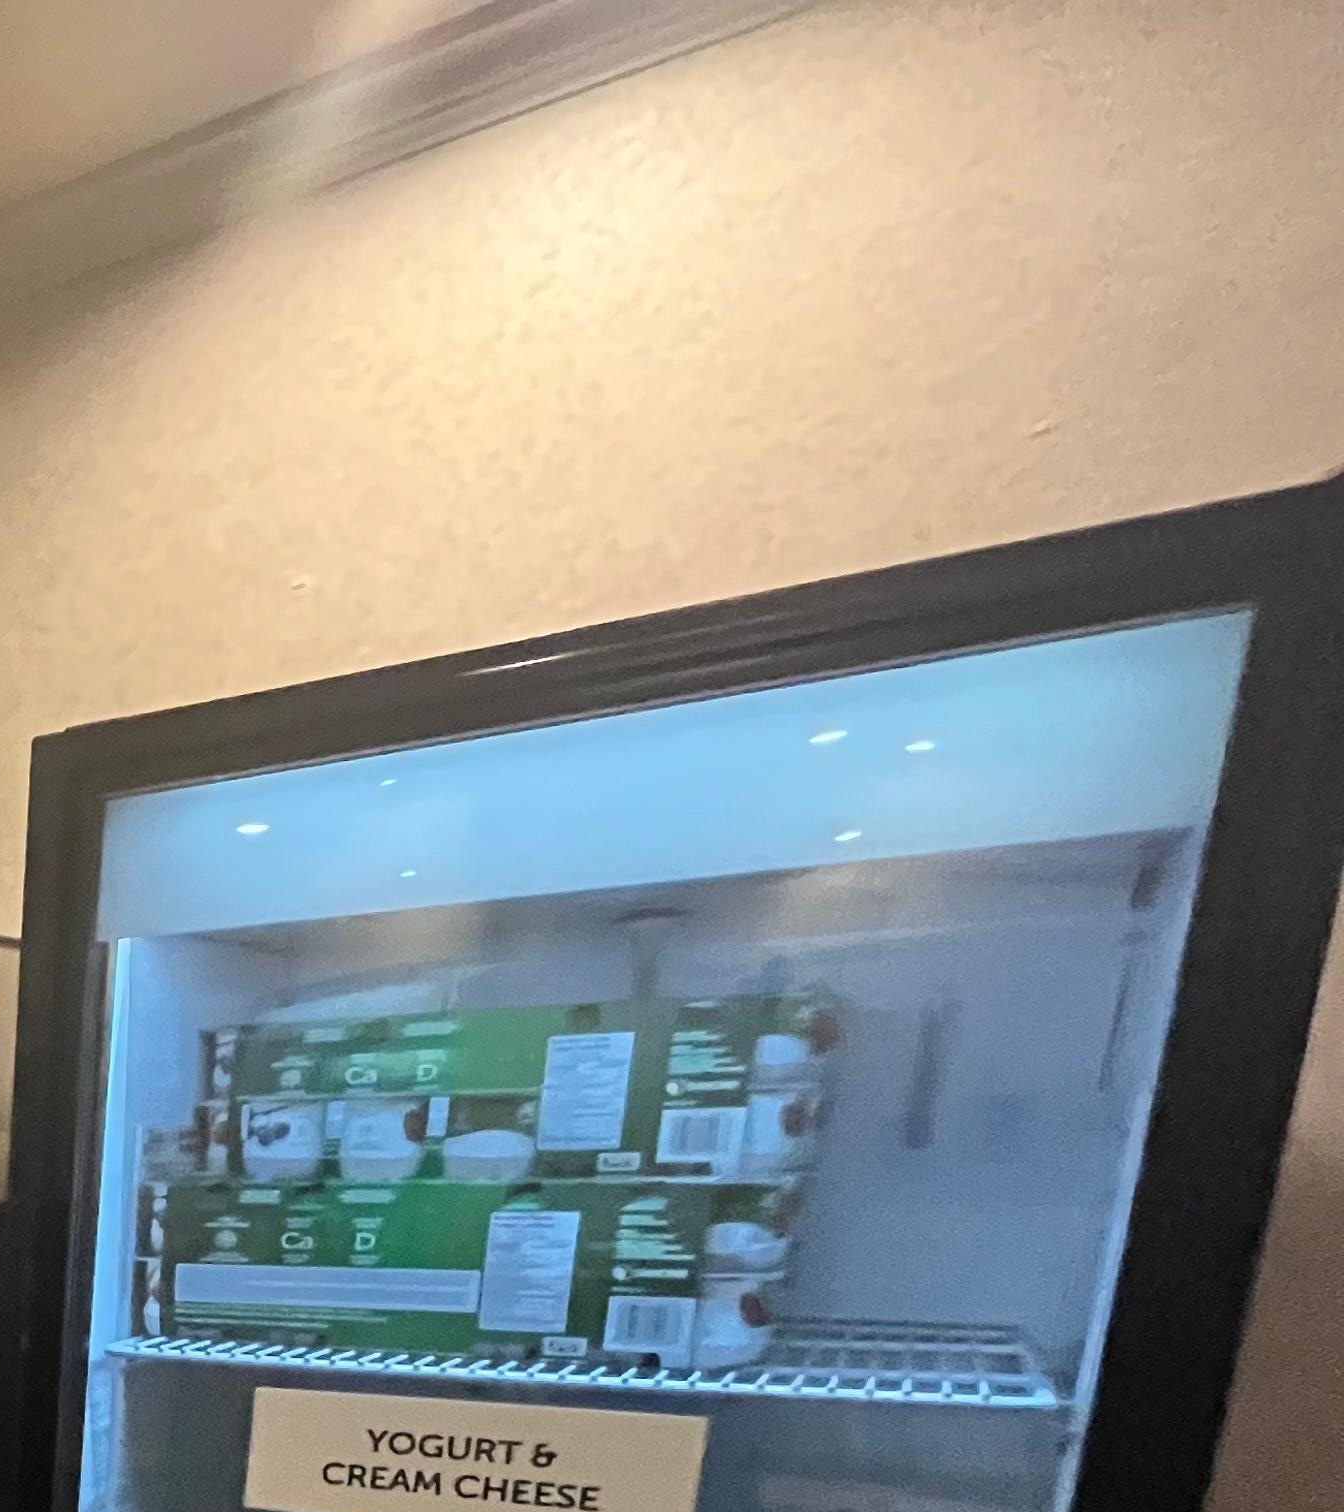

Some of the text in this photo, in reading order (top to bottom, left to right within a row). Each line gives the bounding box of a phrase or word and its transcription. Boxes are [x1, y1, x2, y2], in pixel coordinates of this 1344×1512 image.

[367, 1429, 558, 1468] YOGURT &
[322, 1462, 602, 1512] CREAM CHEESE
